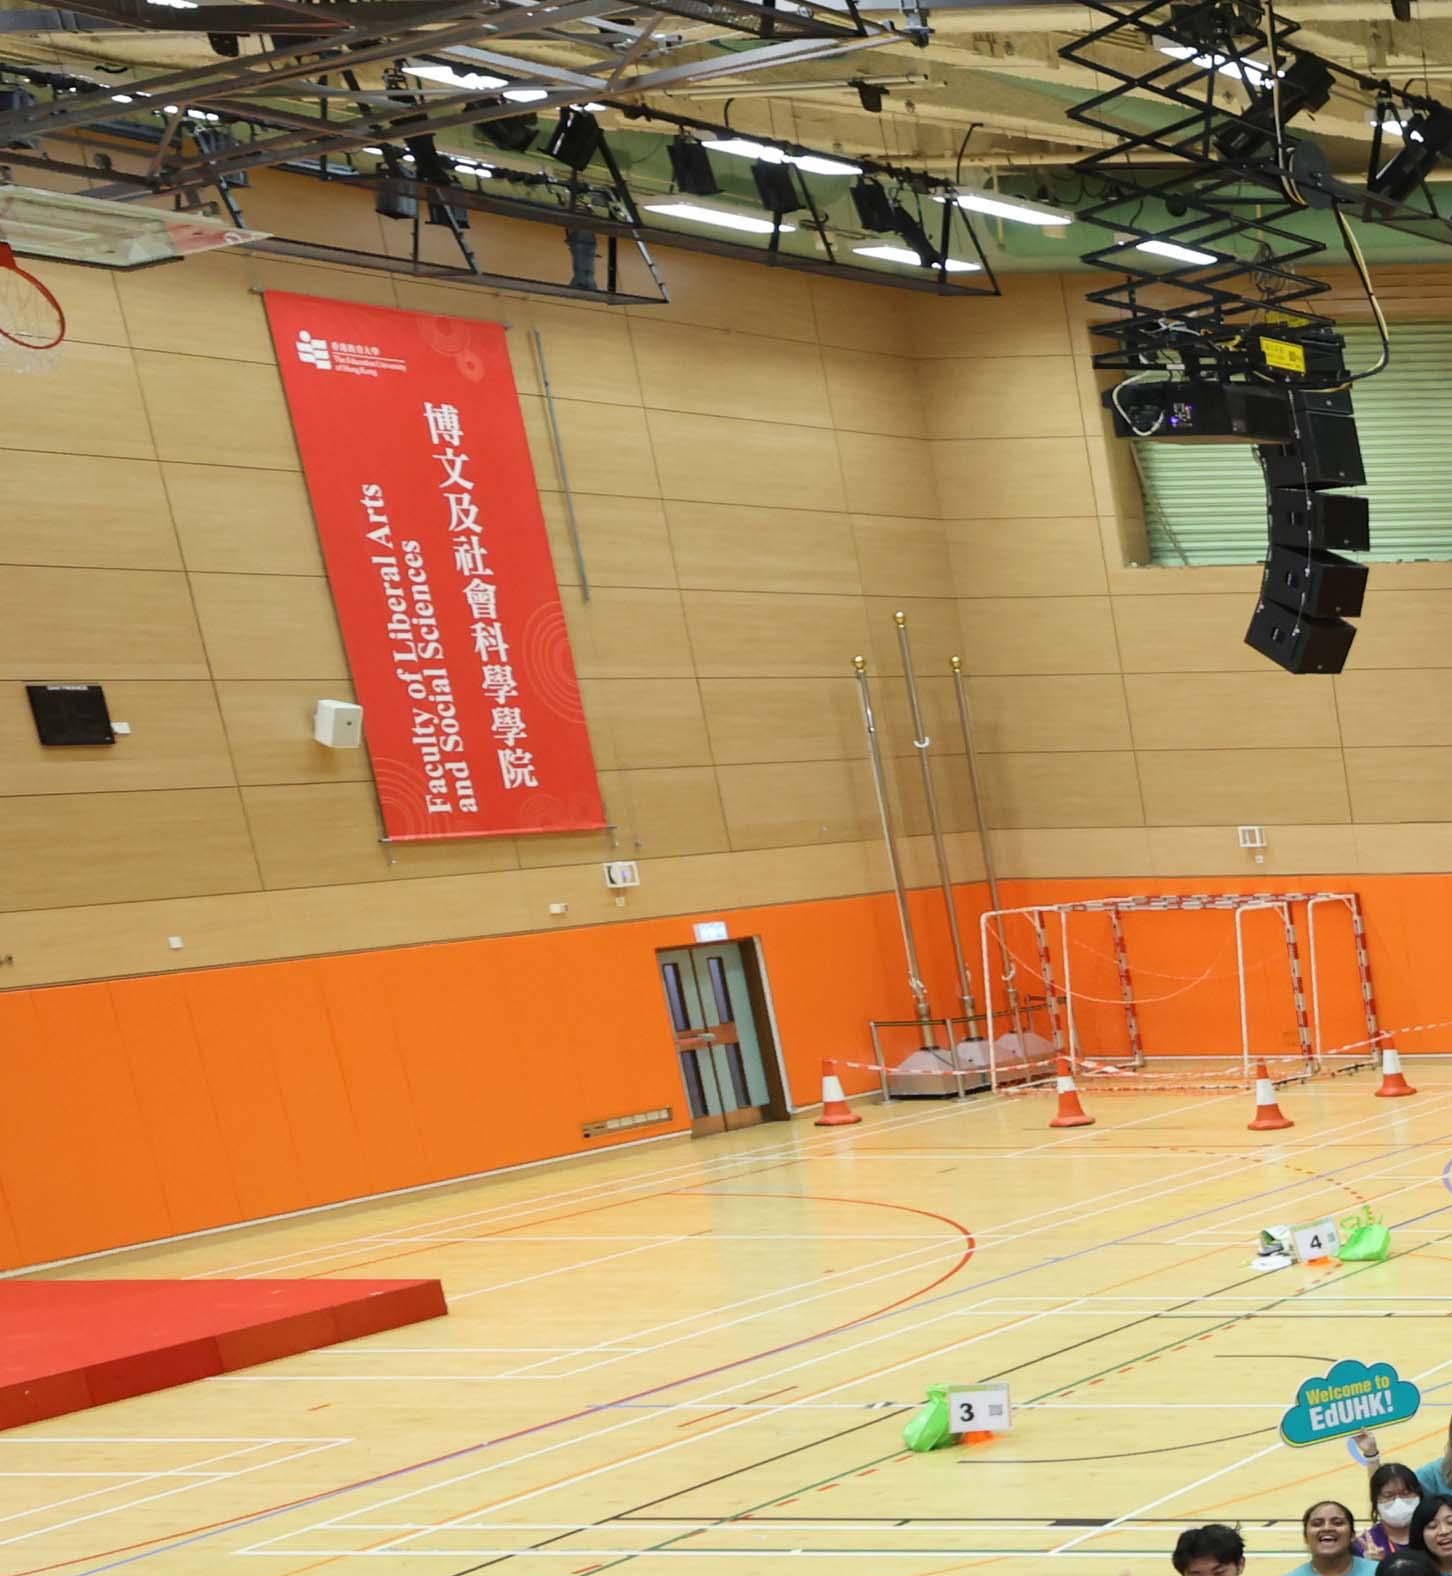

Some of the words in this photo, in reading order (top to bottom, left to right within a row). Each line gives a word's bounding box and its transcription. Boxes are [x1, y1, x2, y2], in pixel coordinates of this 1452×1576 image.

[360, 483, 398, 552] Arts
[378, 555, 419, 666] Liberal
[401, 540, 445, 661] Sciences
[423, 401, 538, 789] 博文及社會科學學院
[406, 668, 427, 704] of
[427, 665, 463, 747] Social
[411, 708, 452, 814] Faculty
[443, 752, 478, 813] and
[1309, 1234, 1323, 1249] 4
[959, 1403, 975, 1421] 3
[1305, 1378, 1372, 1405] Welcome
[1374, 1375, 1391, 1392] to
[1309, 1390, 1394, 1431] EdUHK!
